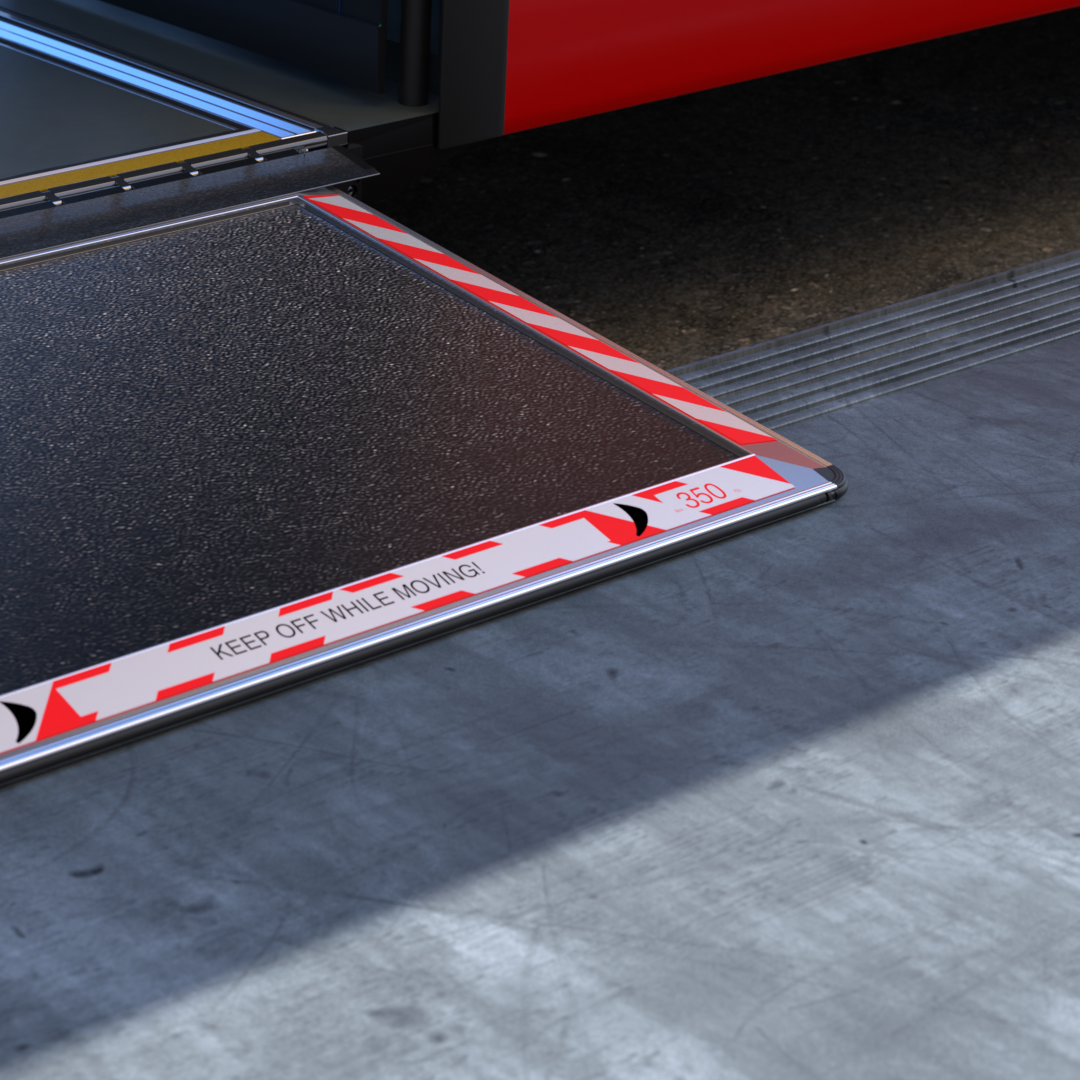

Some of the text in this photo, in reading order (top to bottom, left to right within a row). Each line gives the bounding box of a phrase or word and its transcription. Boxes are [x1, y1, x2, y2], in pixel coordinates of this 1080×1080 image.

[676, 483, 727, 508] 350
[209, 561, 486, 660] KEEP OFF WHILE MOVING!
